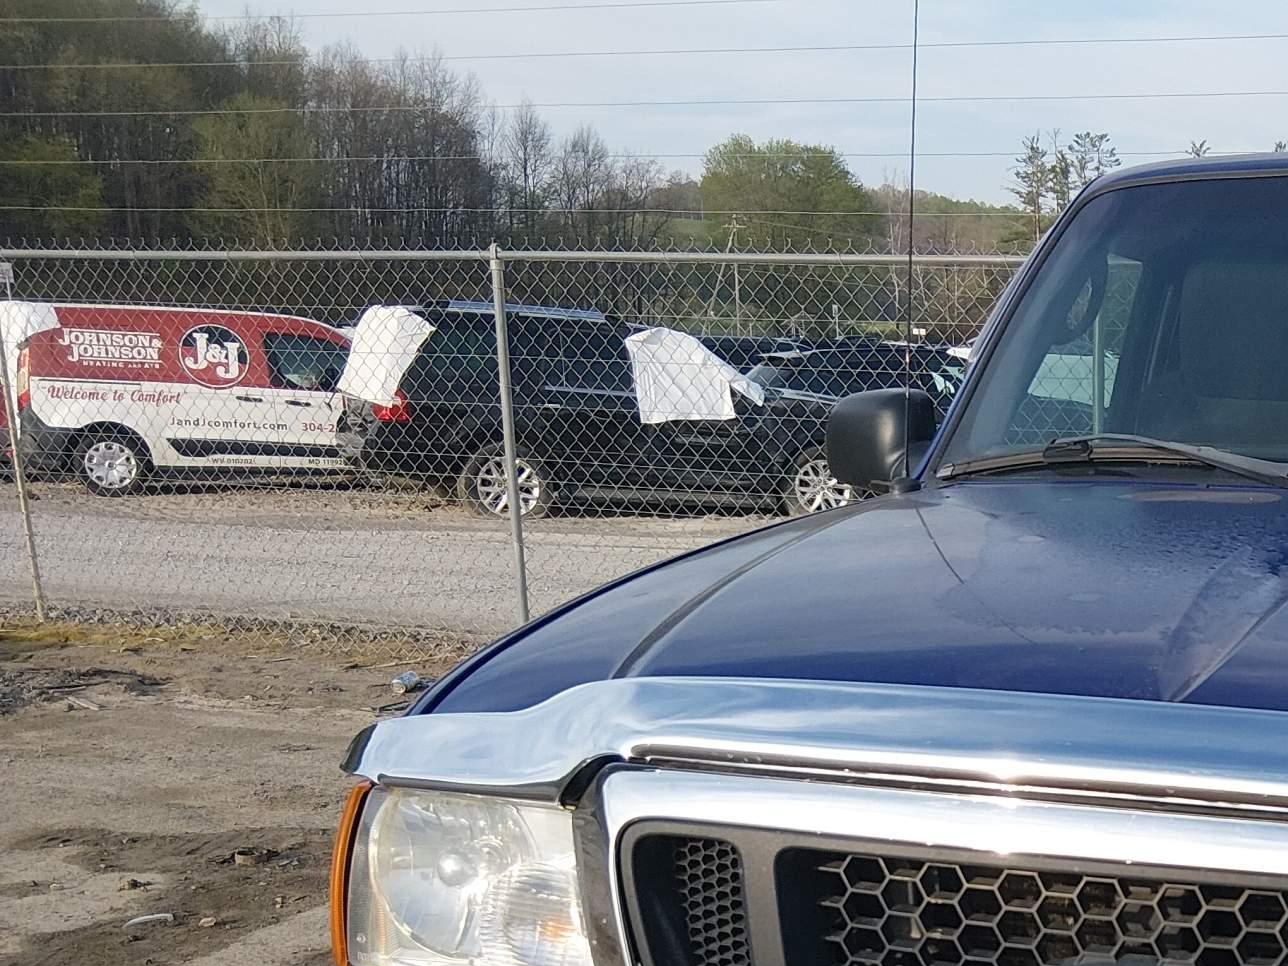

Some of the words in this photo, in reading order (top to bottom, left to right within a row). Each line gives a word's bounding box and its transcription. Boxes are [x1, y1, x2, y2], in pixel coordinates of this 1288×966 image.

[68, 344, 160, 362] JOHNSON
[184, 332, 240, 379] J&J
[47, 384, 108, 401] Welcome
[113, 389, 125, 401] to
[130, 389, 182, 407] Comfort
